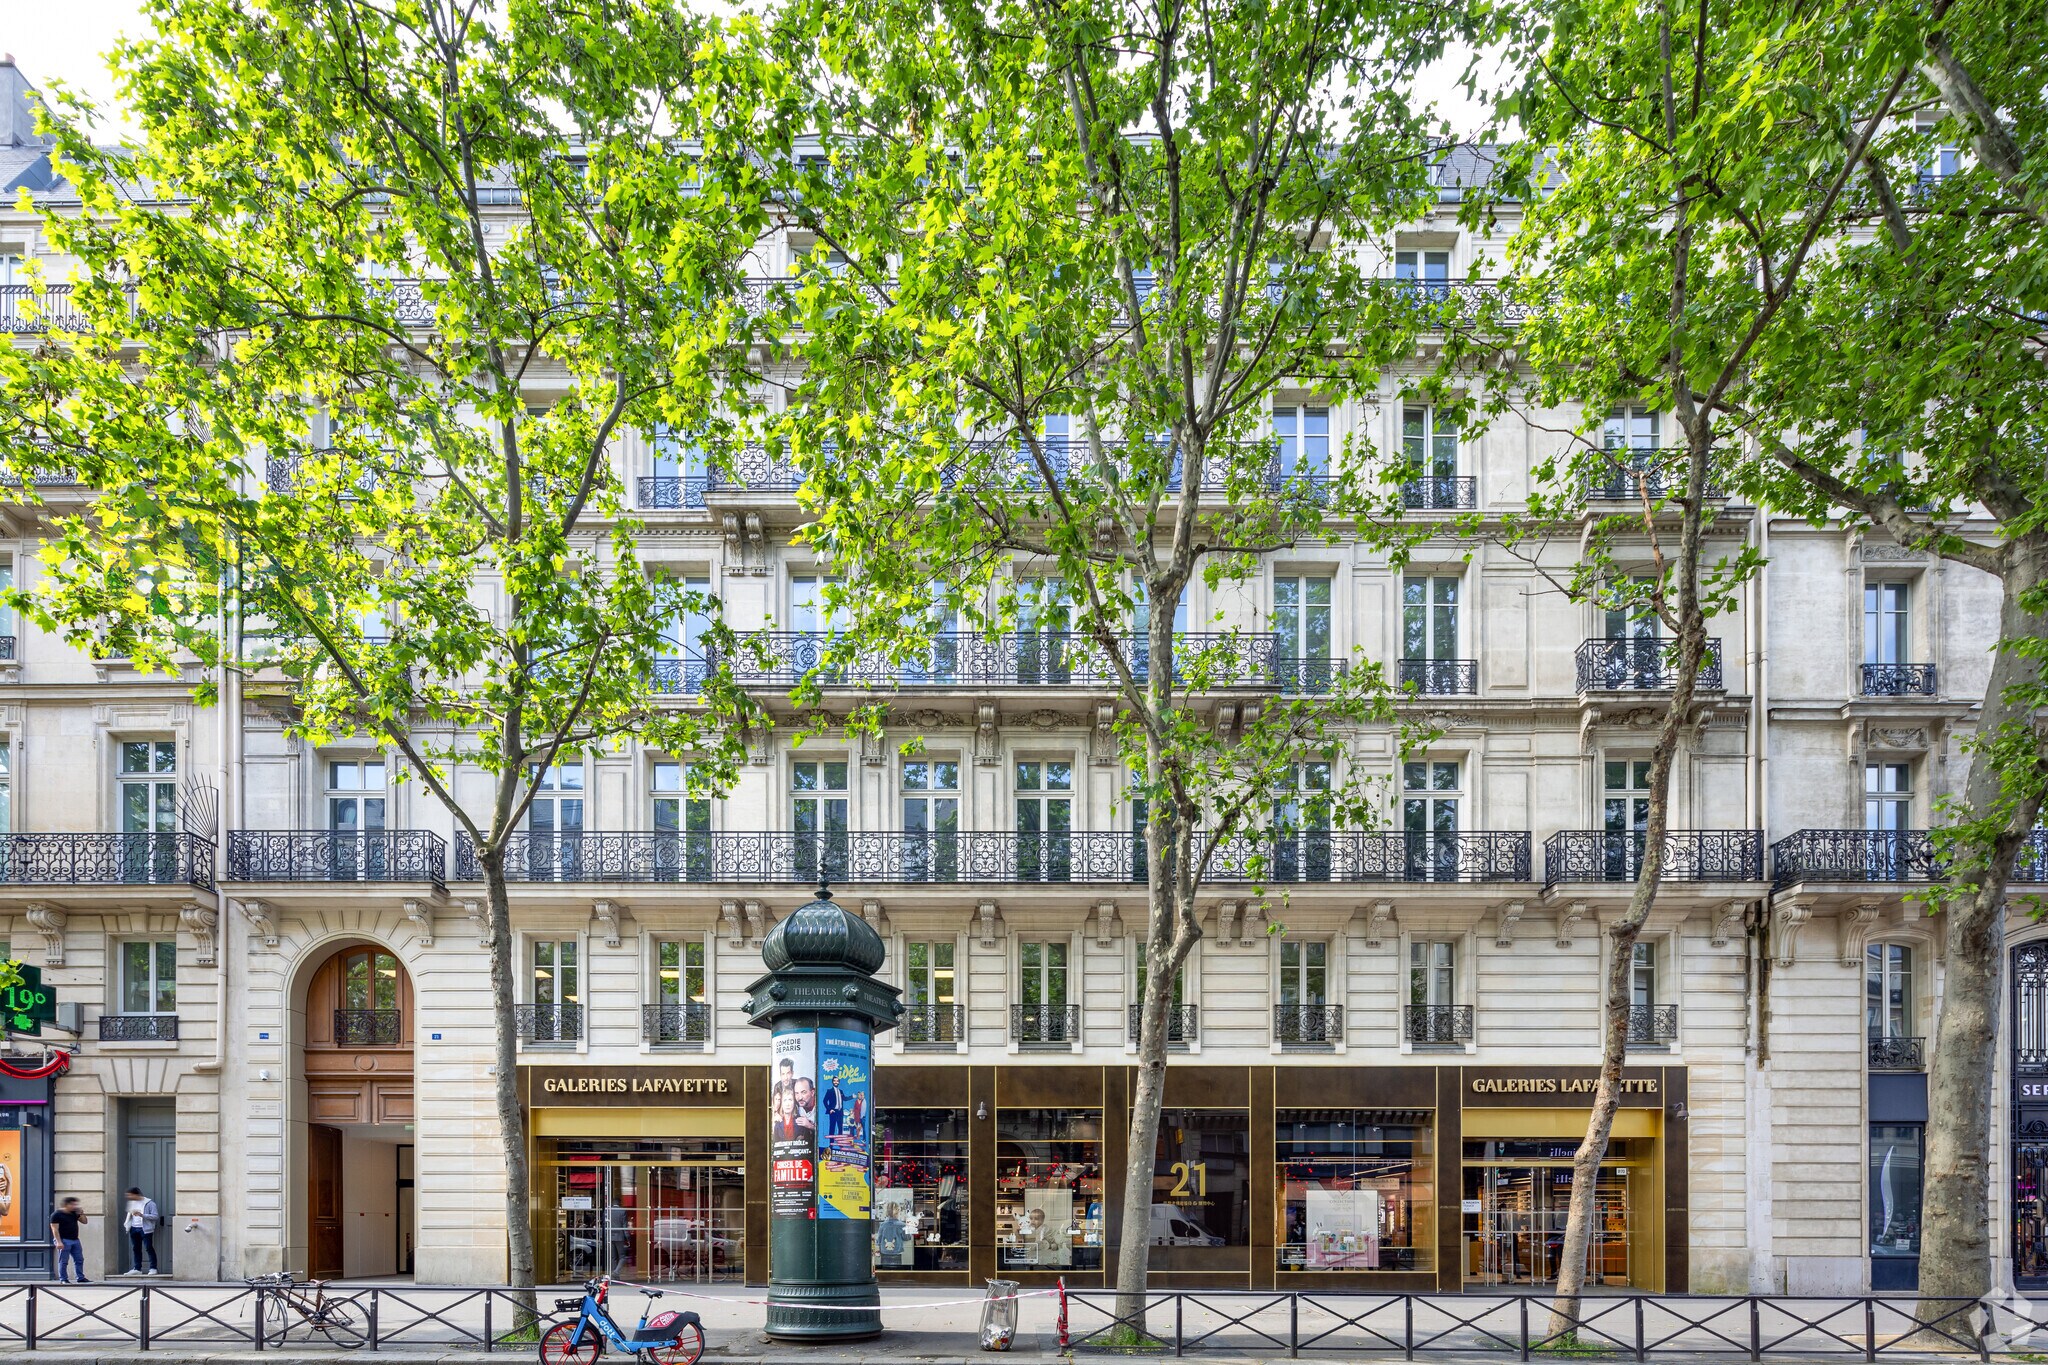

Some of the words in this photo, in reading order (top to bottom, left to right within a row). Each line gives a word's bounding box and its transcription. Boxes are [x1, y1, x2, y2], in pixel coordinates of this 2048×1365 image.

[793, 987, 837, 996] THEATRES
[863, 992, 888, 1008] THEATRES
[776, 1037, 801, 1048] COMÉDIE
[543, 1078, 627, 1092] GALERIES
[632, 1078, 728, 1092] LAFAYETTE
[1472, 1078, 1556, 1093] GALERIES
[1561, 1078, 1657, 1093] LAFATTE
[795, 1160, 803, 1168] DE
[774, 1168, 809, 1182] FAMILLE
[1170, 1162, 1206, 1197] 21
[600, 1320, 616, 1338] dott
